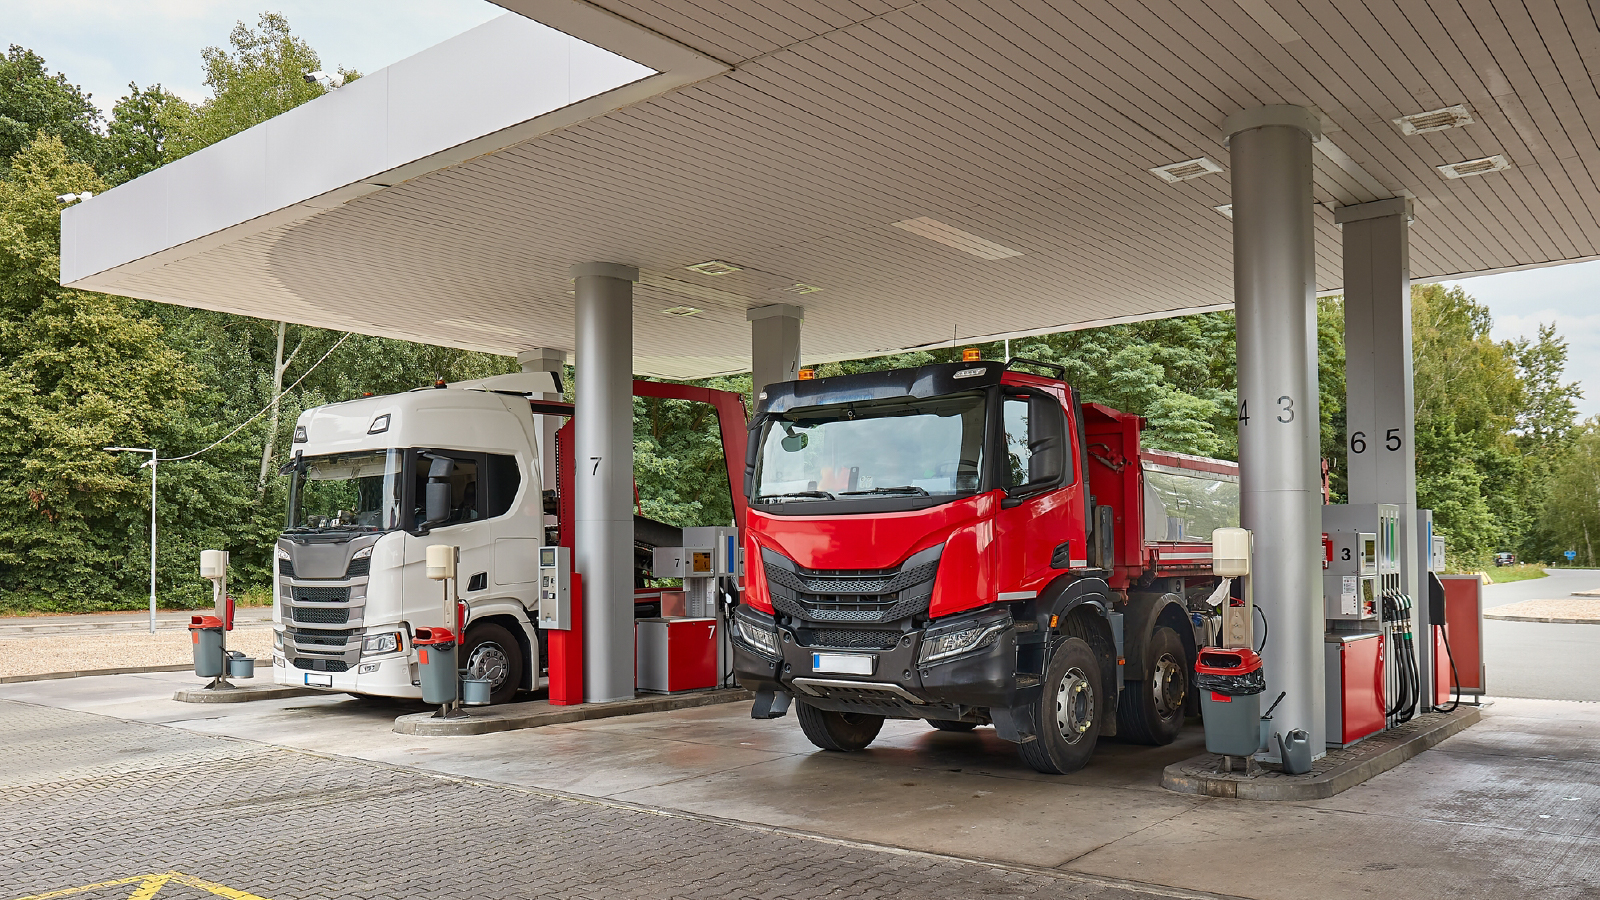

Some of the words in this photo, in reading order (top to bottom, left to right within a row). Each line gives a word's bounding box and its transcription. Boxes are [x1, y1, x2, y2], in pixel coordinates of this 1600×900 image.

[1239, 399, 1250, 426] 4
[1277, 396, 1294, 423] 3
[1351, 431, 1366, 454] 6
[1386, 428, 1401, 451] 5
[589, 456, 602, 476] 7
[675, 559, 680, 567] 7
[1341, 547, 1351, 561] 3
[707, 625, 716, 640] 7
[1379, 642, 1384, 662] 3
